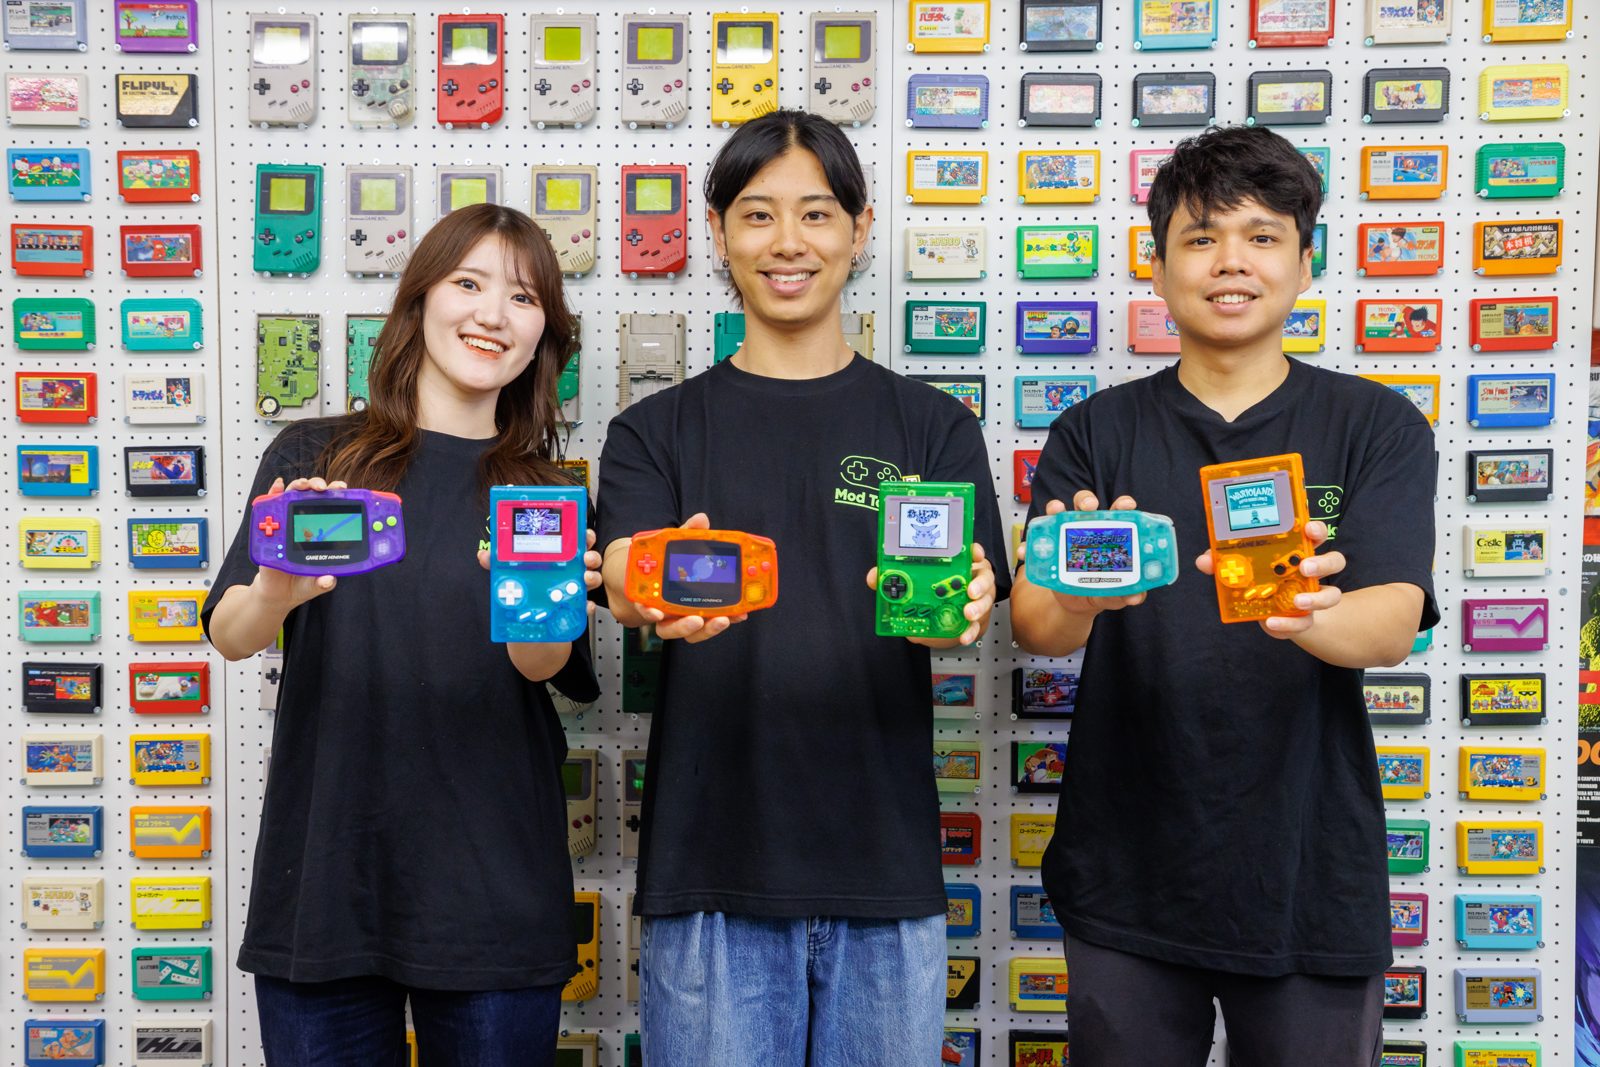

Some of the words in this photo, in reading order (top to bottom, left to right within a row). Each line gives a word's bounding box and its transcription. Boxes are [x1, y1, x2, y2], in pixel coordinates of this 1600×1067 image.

[1506, 237, 1533, 250] 本将棋
[835, 488, 866, 503] Mod
[1477, 537, 1502, 547] Castle
